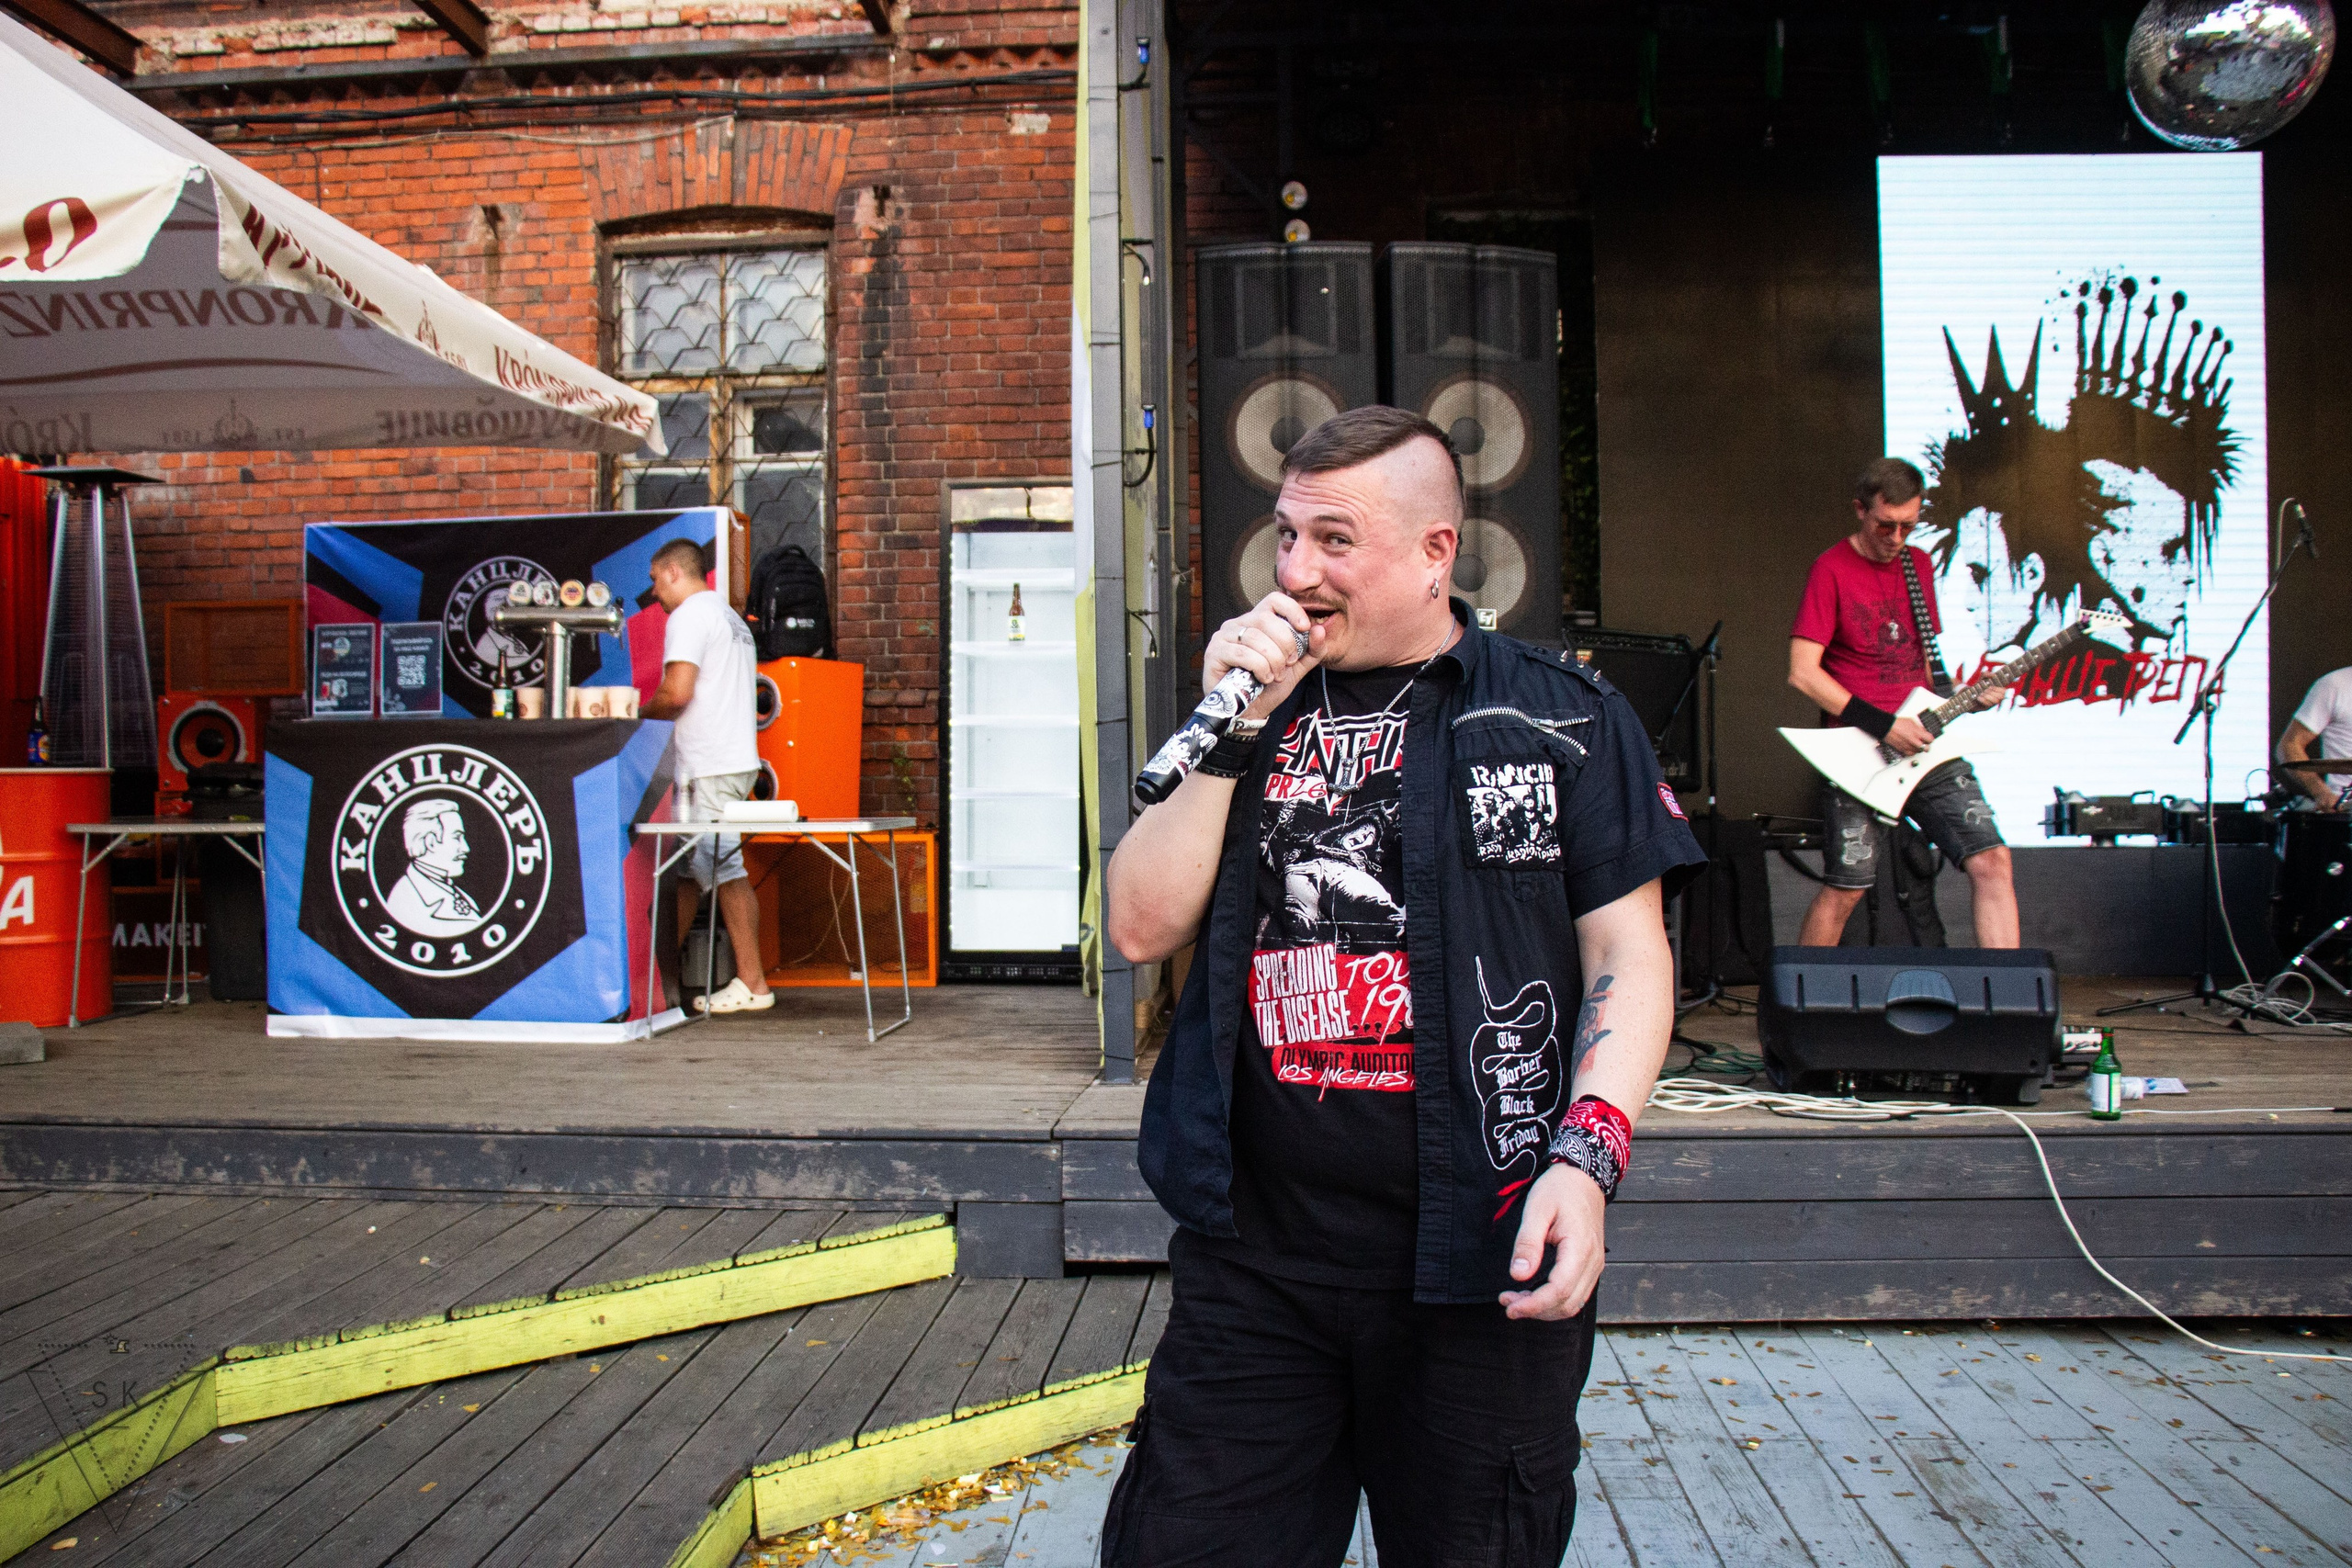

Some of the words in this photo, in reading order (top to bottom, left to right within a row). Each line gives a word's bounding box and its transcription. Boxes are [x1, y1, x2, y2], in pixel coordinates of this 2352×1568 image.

[340, 753, 543, 875] КАНЦЛЕРЪ
[375, 923, 507, 964] 2010
[1254, 944, 1339, 1000] SPREADING
[1255, 999, 1284, 1046] THE
[1282, 989, 1354, 1043] DISEASE
[1497, 1031, 1521, 1051] The
[1278, 1064, 1313, 1081] LOS
[1280, 1047, 1345, 1073] OLYMPIC
[1495, 1055, 1543, 1089] Barber
[1499, 1095, 1535, 1116] Black
[1498, 1125, 1541, 1159] Friday
